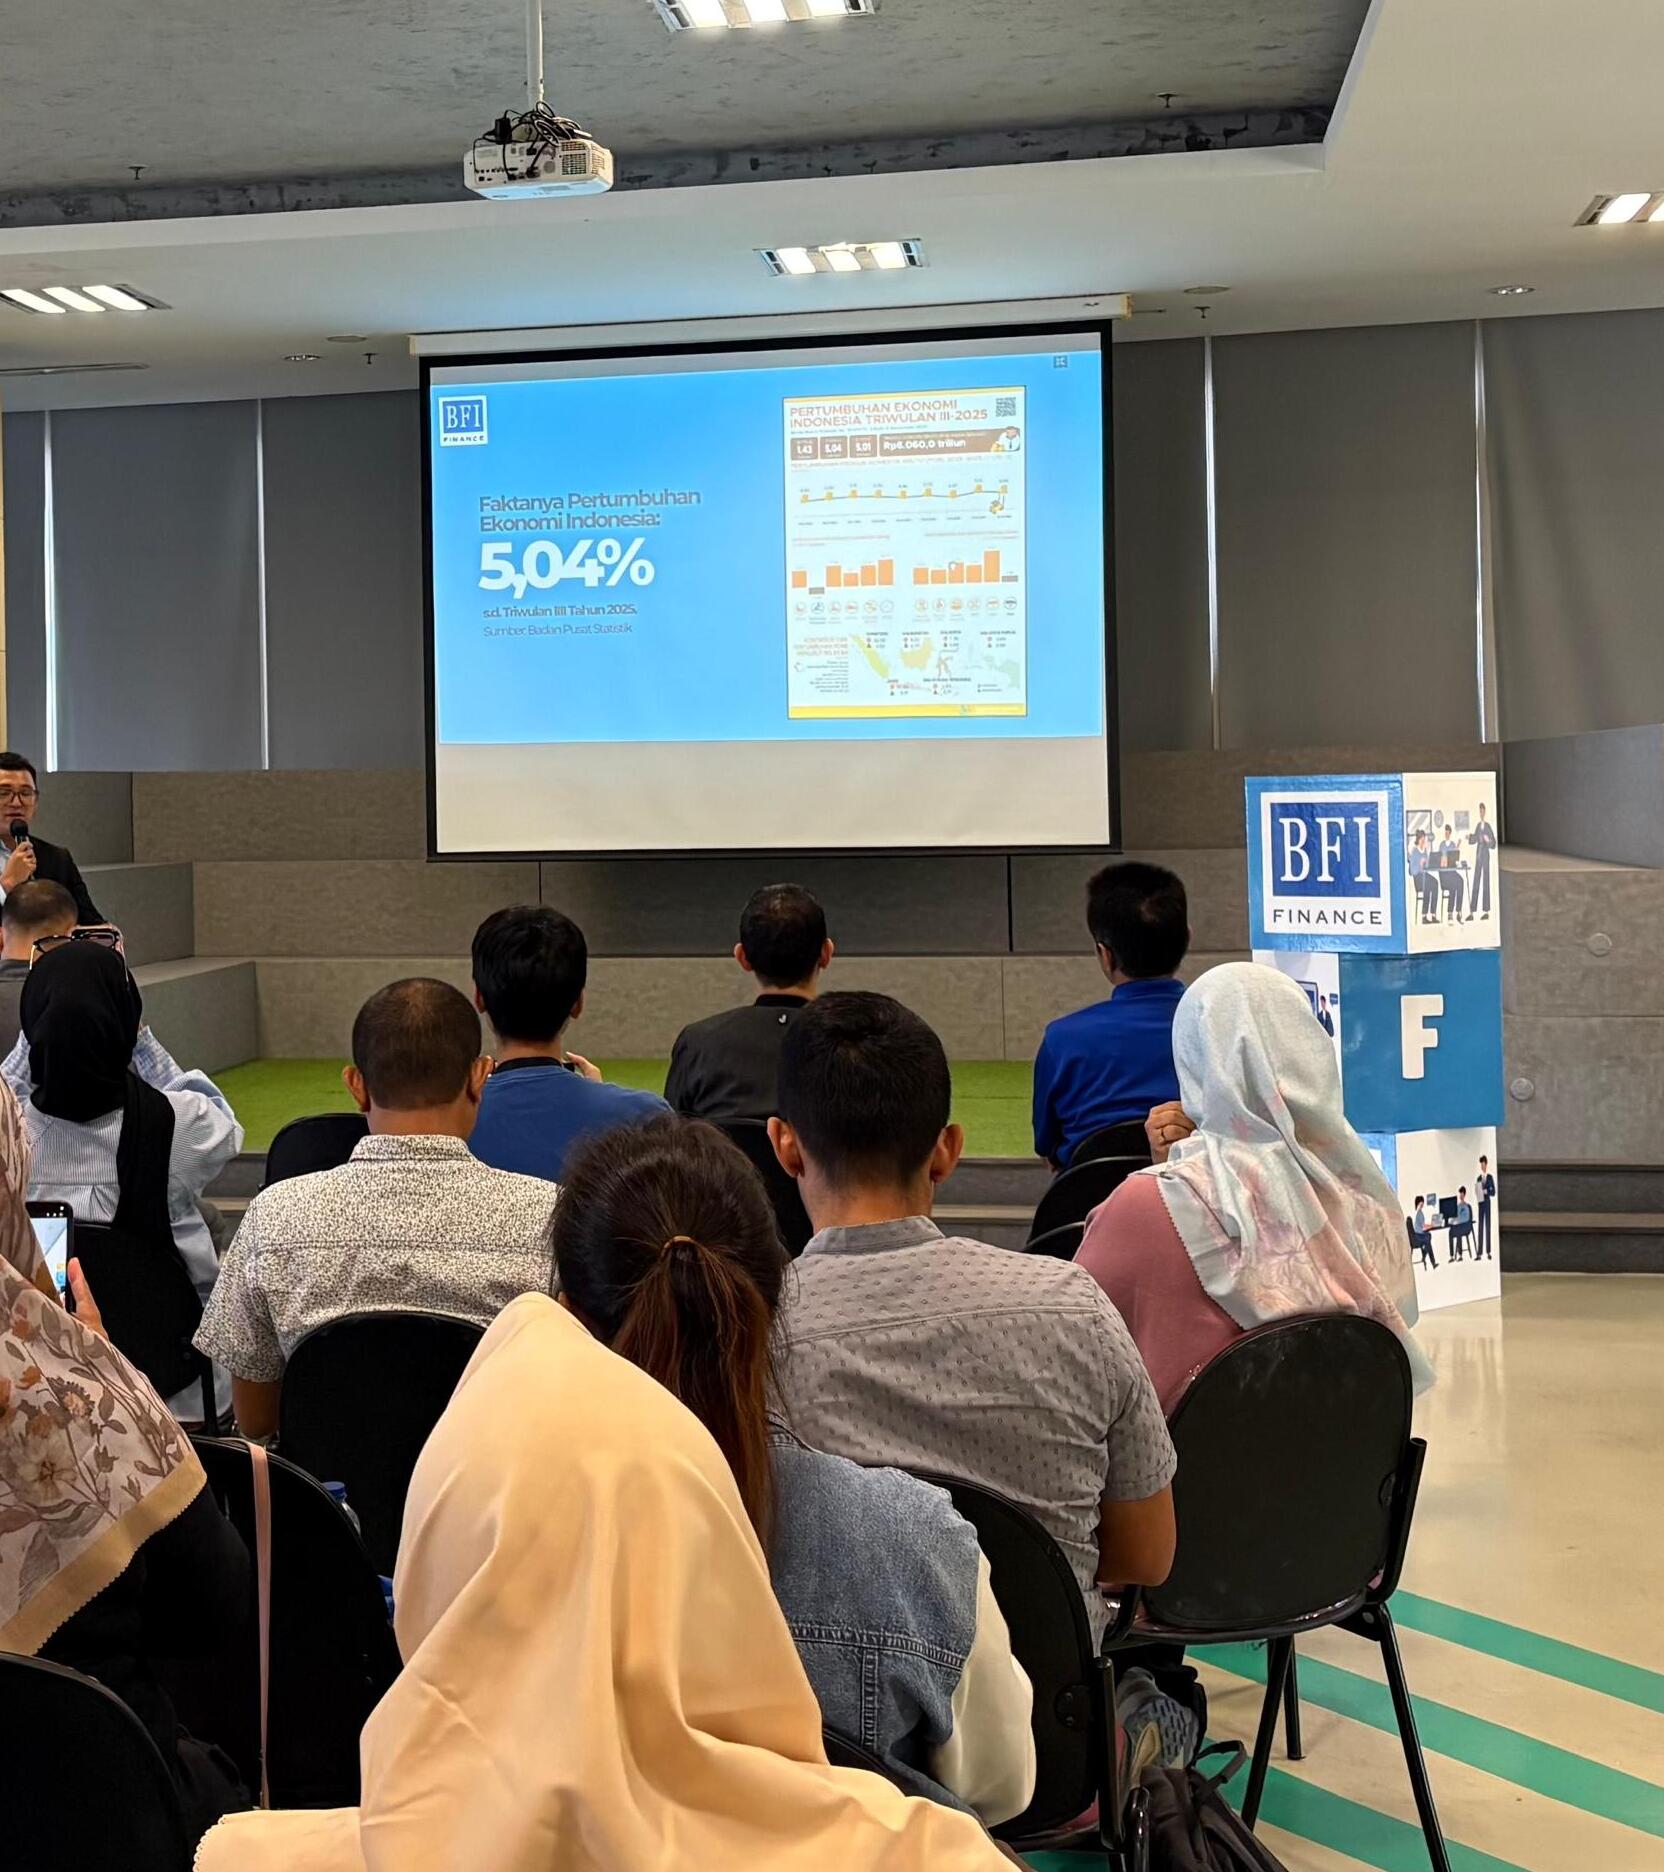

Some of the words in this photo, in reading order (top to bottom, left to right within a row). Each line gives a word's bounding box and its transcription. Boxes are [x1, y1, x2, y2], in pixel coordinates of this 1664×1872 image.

[446, 403, 481, 430] BFI
[790, 402, 891, 417] PERTUMBUHAN
[895, 399, 958, 412] EKONOMI
[790, 416, 862, 428] INDONESIA
[867, 412, 938, 425] TRIWULAN
[443, 434, 485, 443] FINANCE
[479, 495, 564, 515] Faktanya
[567, 488, 701, 510] Pertumbuhan
[480, 512, 563, 532] Ekonomi
[566, 509, 661, 530] Indonesia:
[478, 537, 655, 599] 5,04%
[502, 605, 553, 617] Triwulan
[567, 604, 606, 616] Tahun
[528, 624, 562, 636] Badan
[563, 623, 592, 635] Pusat
[593, 622, 633, 634] Statistik
[1278, 816, 1374, 883] BFI
[1273, 909, 1383, 925] FINANCE
[1400, 994, 1444, 1080] F
